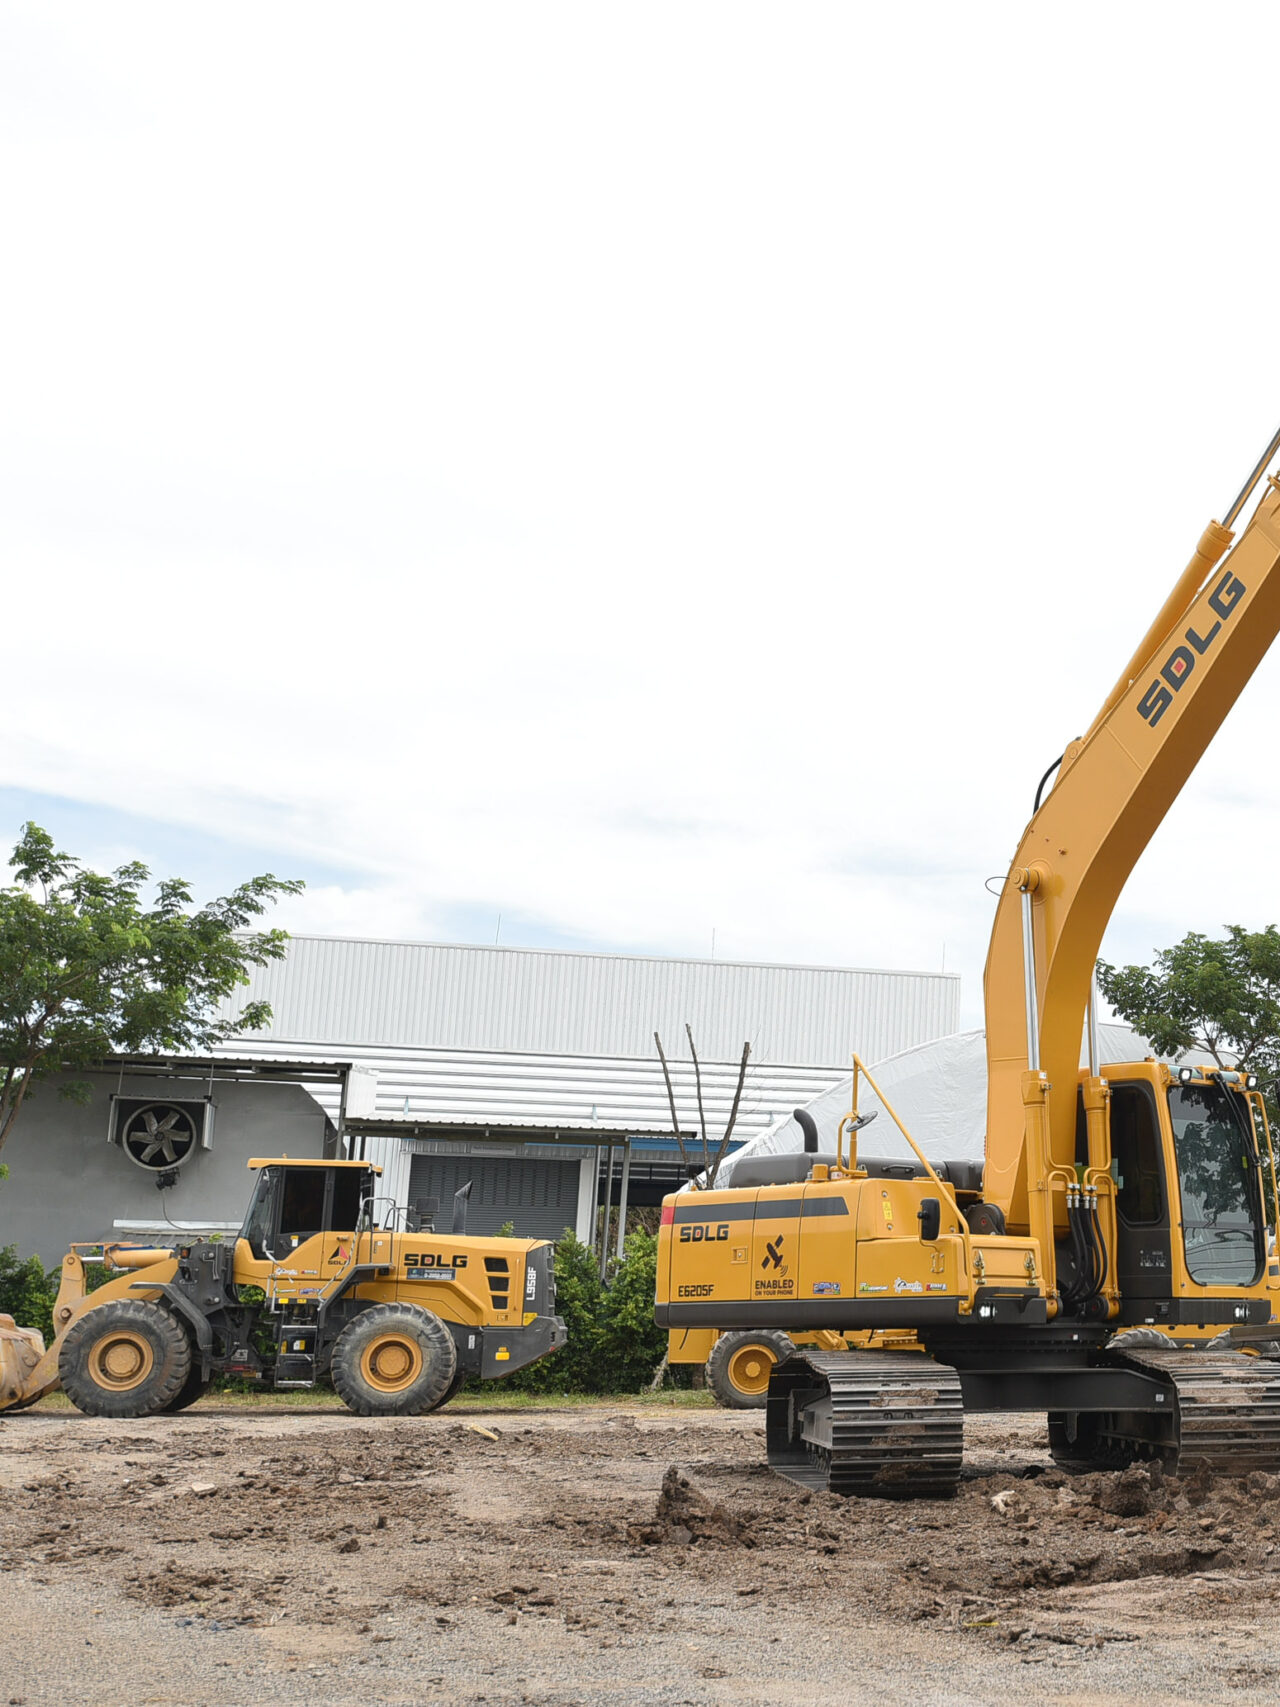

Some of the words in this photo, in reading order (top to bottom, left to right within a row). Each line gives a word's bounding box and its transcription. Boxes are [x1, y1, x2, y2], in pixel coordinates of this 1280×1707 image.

[1136, 570, 1246, 728] SDLG
[680, 1224, 729, 1243] SDLG
[404, 1254, 468, 1268] SDLG
[526, 1267, 537, 1301] L958F
[678, 1284, 714, 1297] E6205F
[755, 1279, 794, 1289] ENABLED
